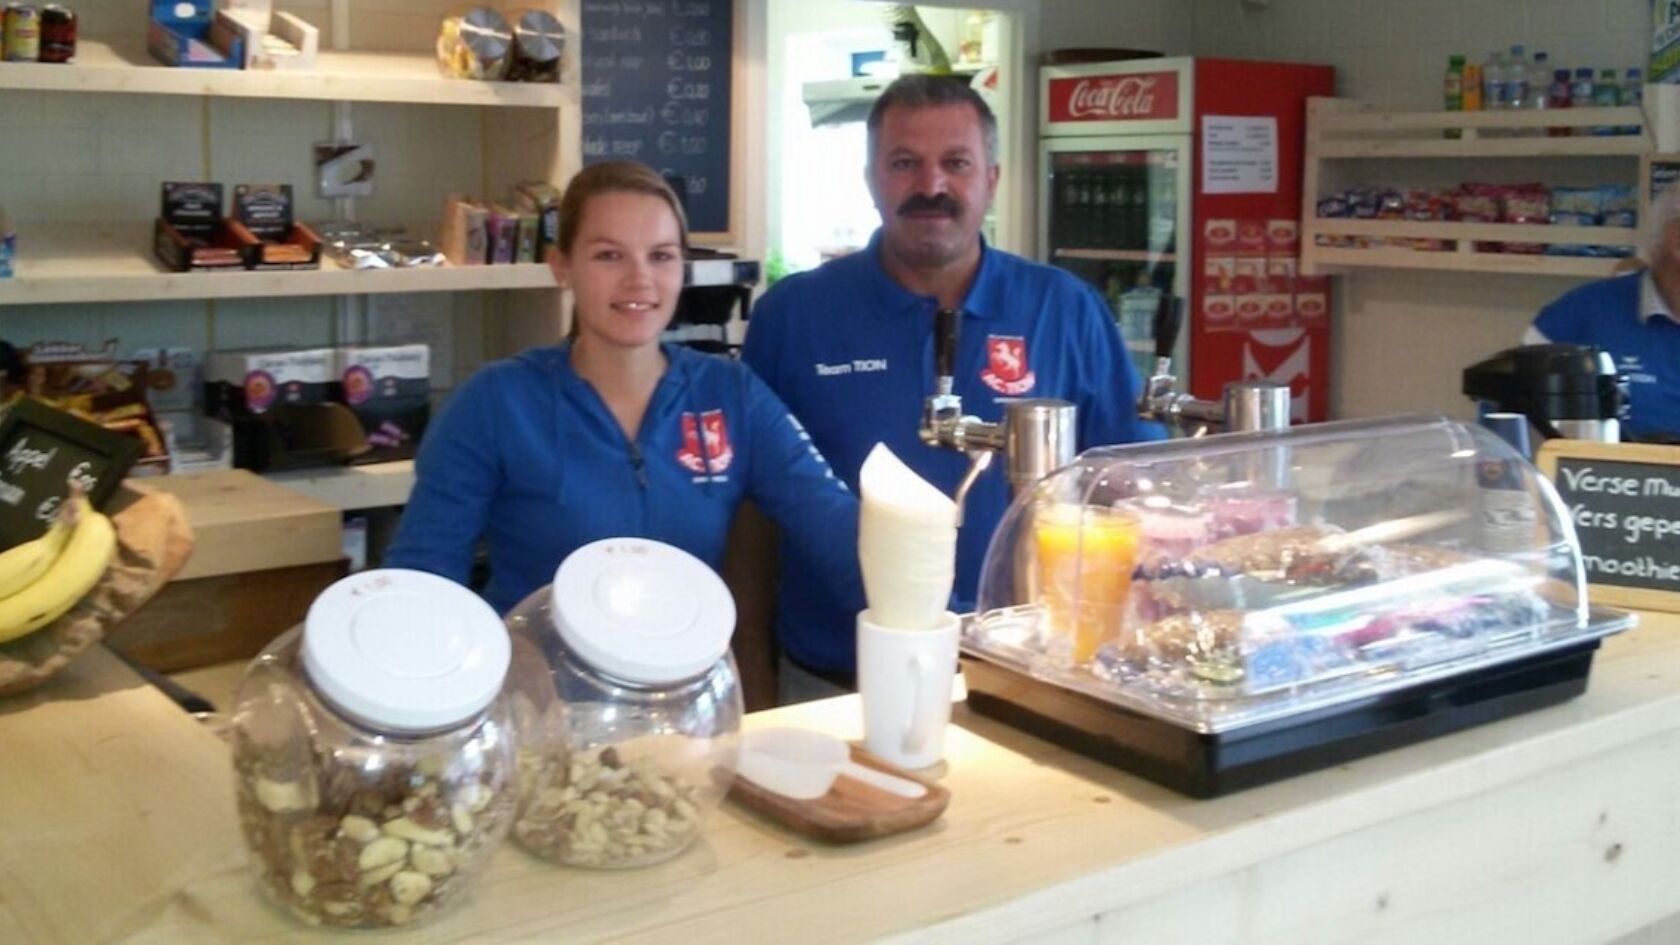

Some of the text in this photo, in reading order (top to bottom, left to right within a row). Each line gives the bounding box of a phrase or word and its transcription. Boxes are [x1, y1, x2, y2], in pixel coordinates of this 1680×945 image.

[815, 359, 887, 376] Team TION
[6, 437, 58, 475] Appel
[1561, 467, 1640, 496] Verse
[1582, 555, 1680, 580] moothie
